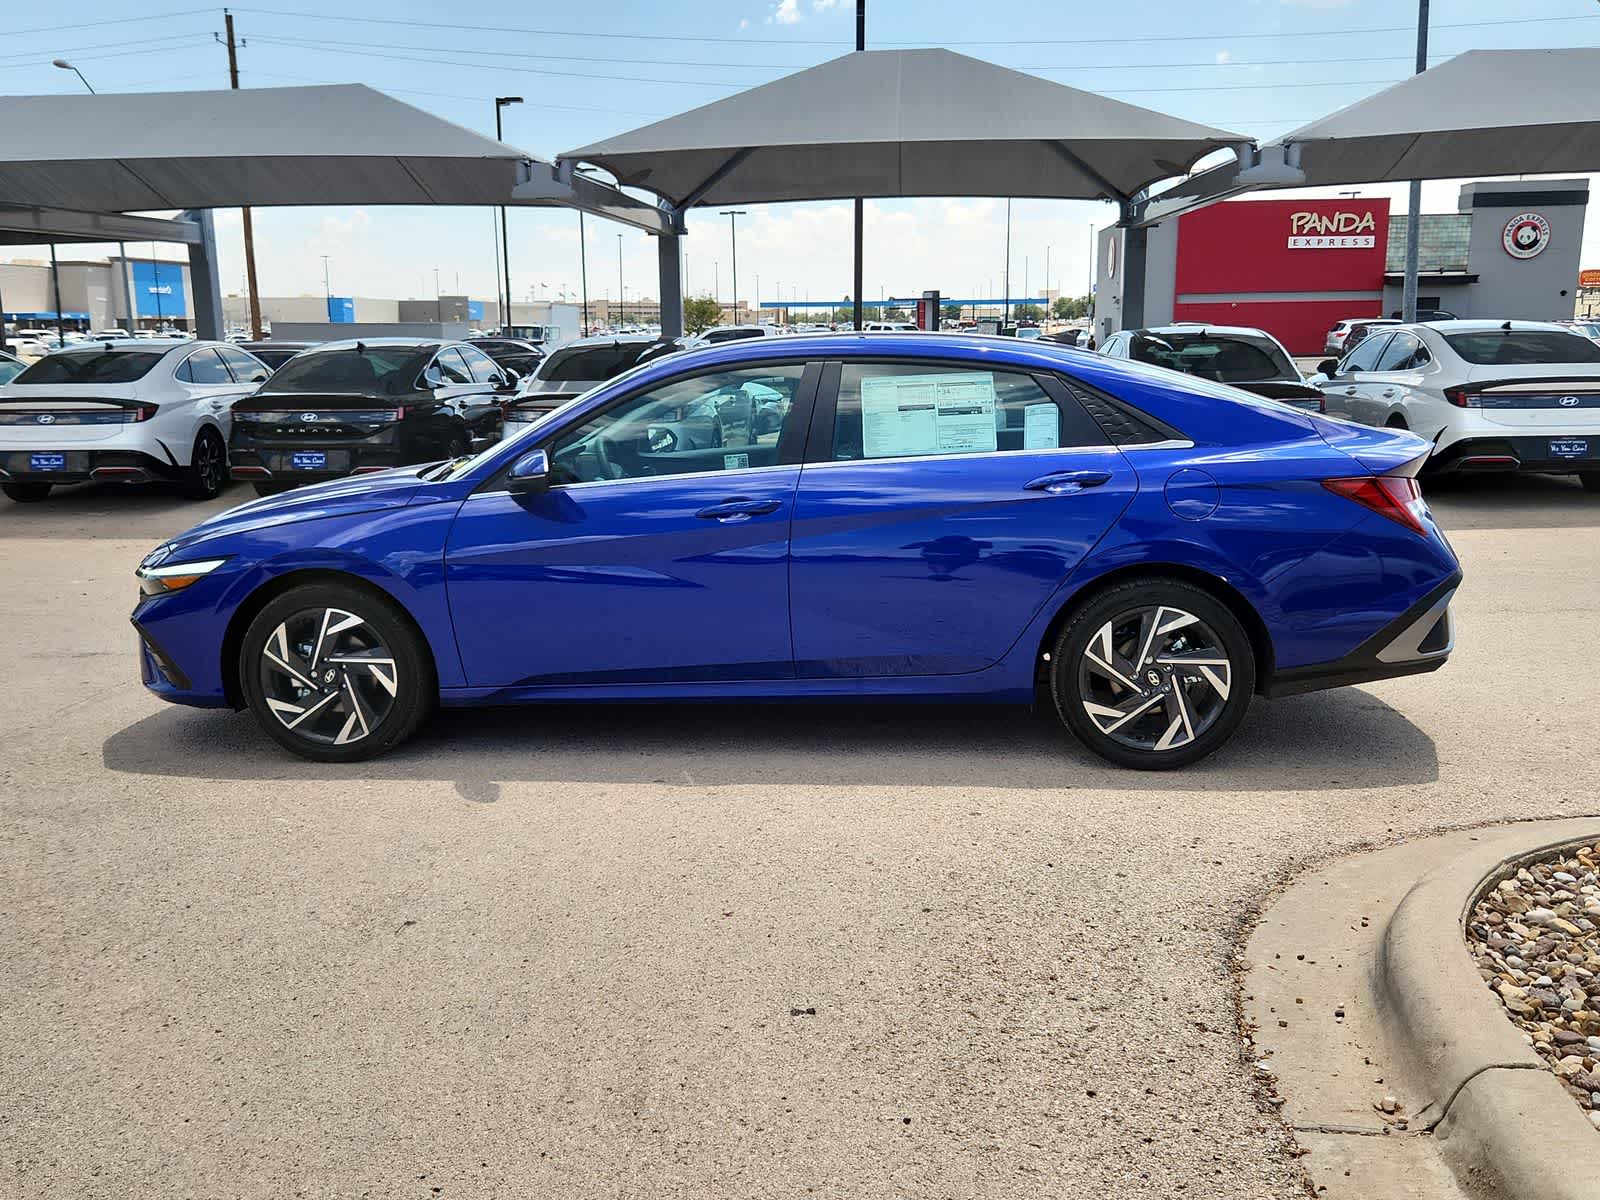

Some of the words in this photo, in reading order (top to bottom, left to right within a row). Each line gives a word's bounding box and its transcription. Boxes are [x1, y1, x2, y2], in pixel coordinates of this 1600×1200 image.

[1290, 211, 1376, 235] PANDA
[1506, 216, 1525, 237] PANDA
[1293, 239, 1370, 247] EXPRESS
